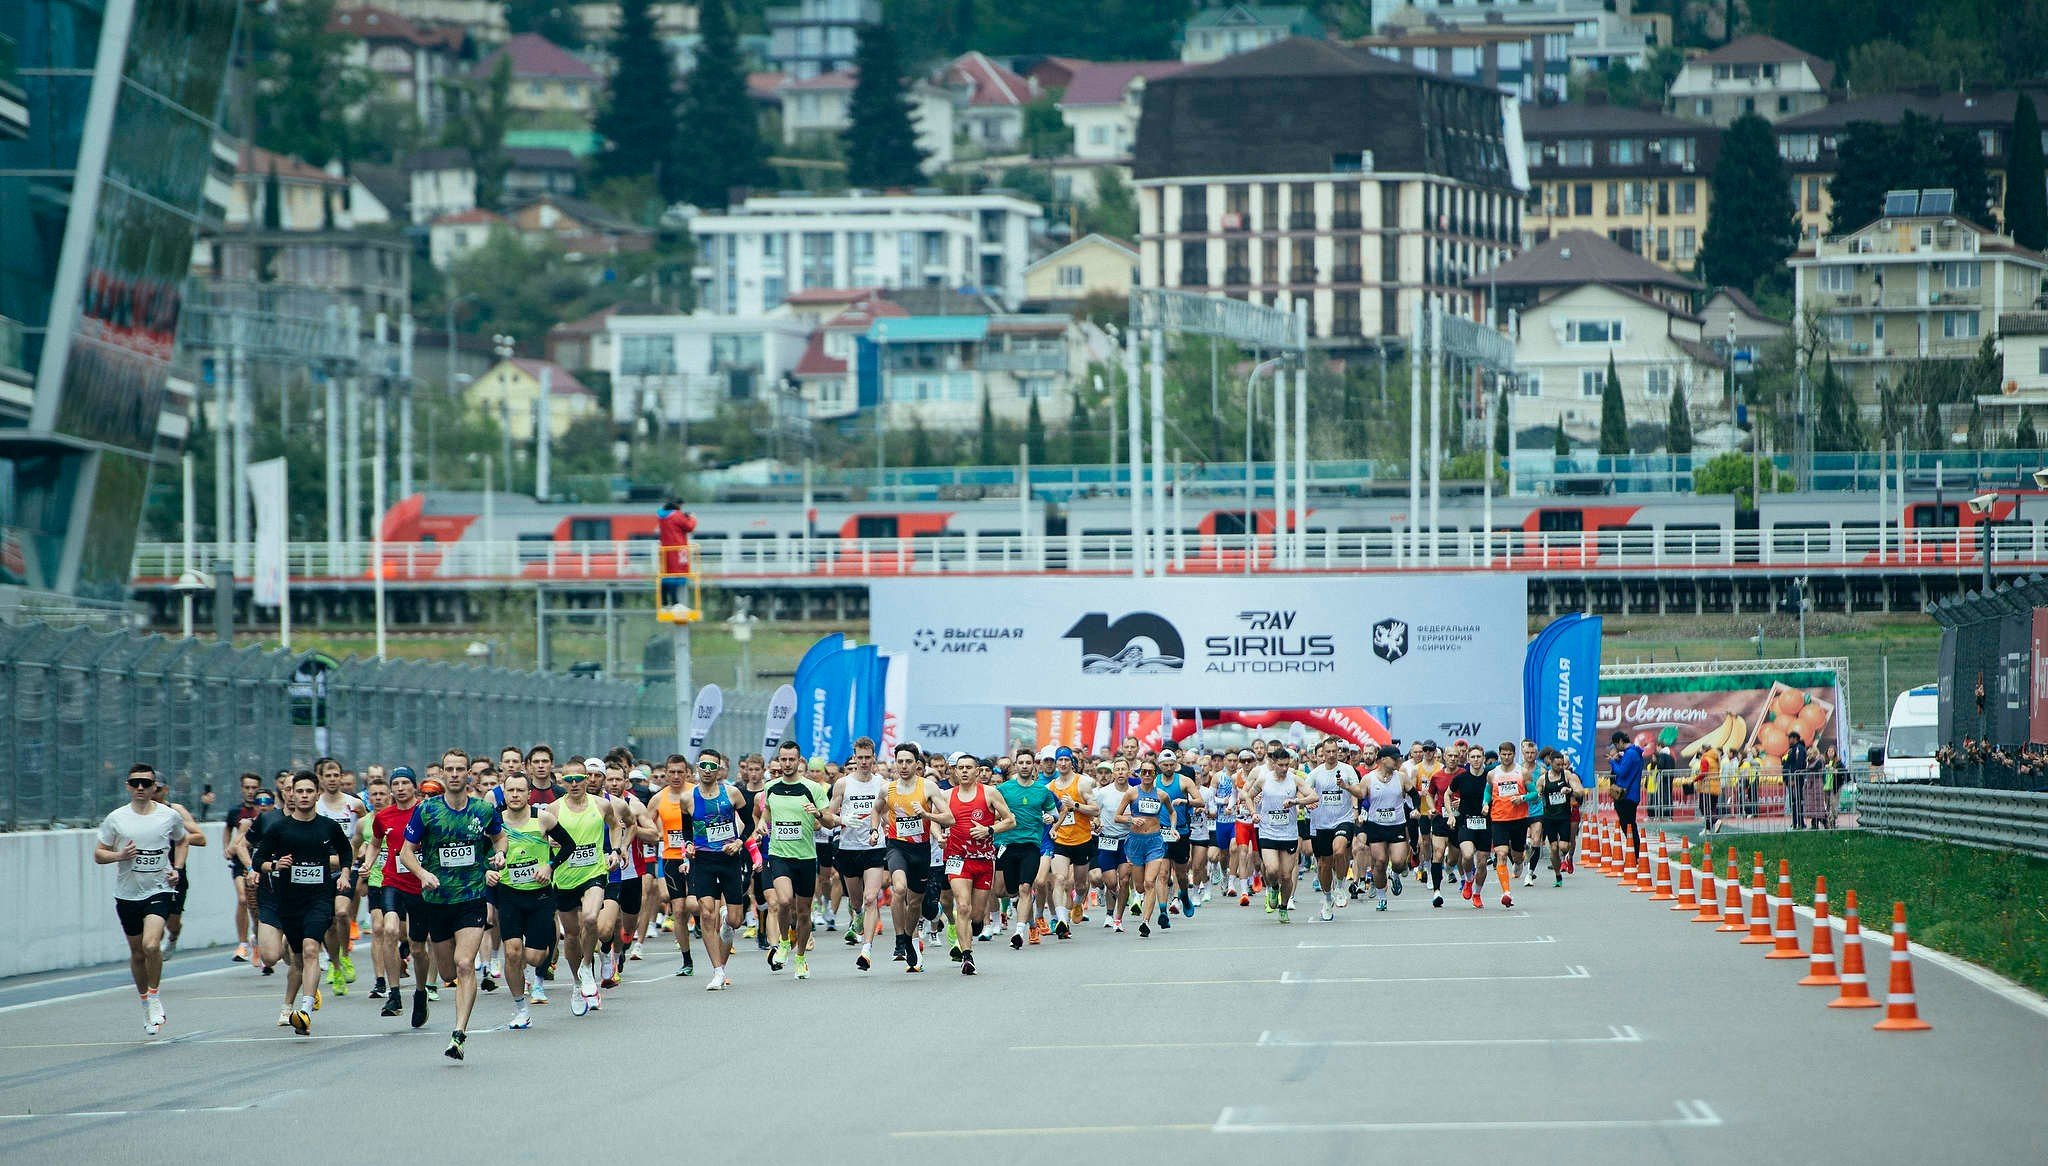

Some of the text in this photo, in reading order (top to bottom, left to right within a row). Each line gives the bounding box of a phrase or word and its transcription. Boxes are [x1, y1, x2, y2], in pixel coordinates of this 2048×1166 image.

[944, 628, 1024, 639] ВЫСШАЯ
[1417, 624, 1480, 633] ФЕДЕРАЛЬНАЯ
[1417, 634, 1473, 642] ТЕРРИТОРИЯ
[941, 642, 988, 653] ЛИГА
[1205, 635, 1335, 657] SIRIUS
[1205, 660, 1335, 673] AUTODROM
[1558, 657, 1571, 742] ВЫСШАЯ
[1624, 694, 1708, 722] Свежесть
[1571, 695, 1583, 744] ЛИГА
[854, 801, 873, 809] 6481
[710, 825, 730, 835] 7716
[900, 820, 920, 830] 7691
[778, 827, 799, 835] 2036
[443, 846, 472, 858] 6603
[570, 848, 595, 860] 7565
[136, 856, 160, 866] 6387
[294, 868, 321, 878] 6542
[514, 867, 536, 879] 6411
